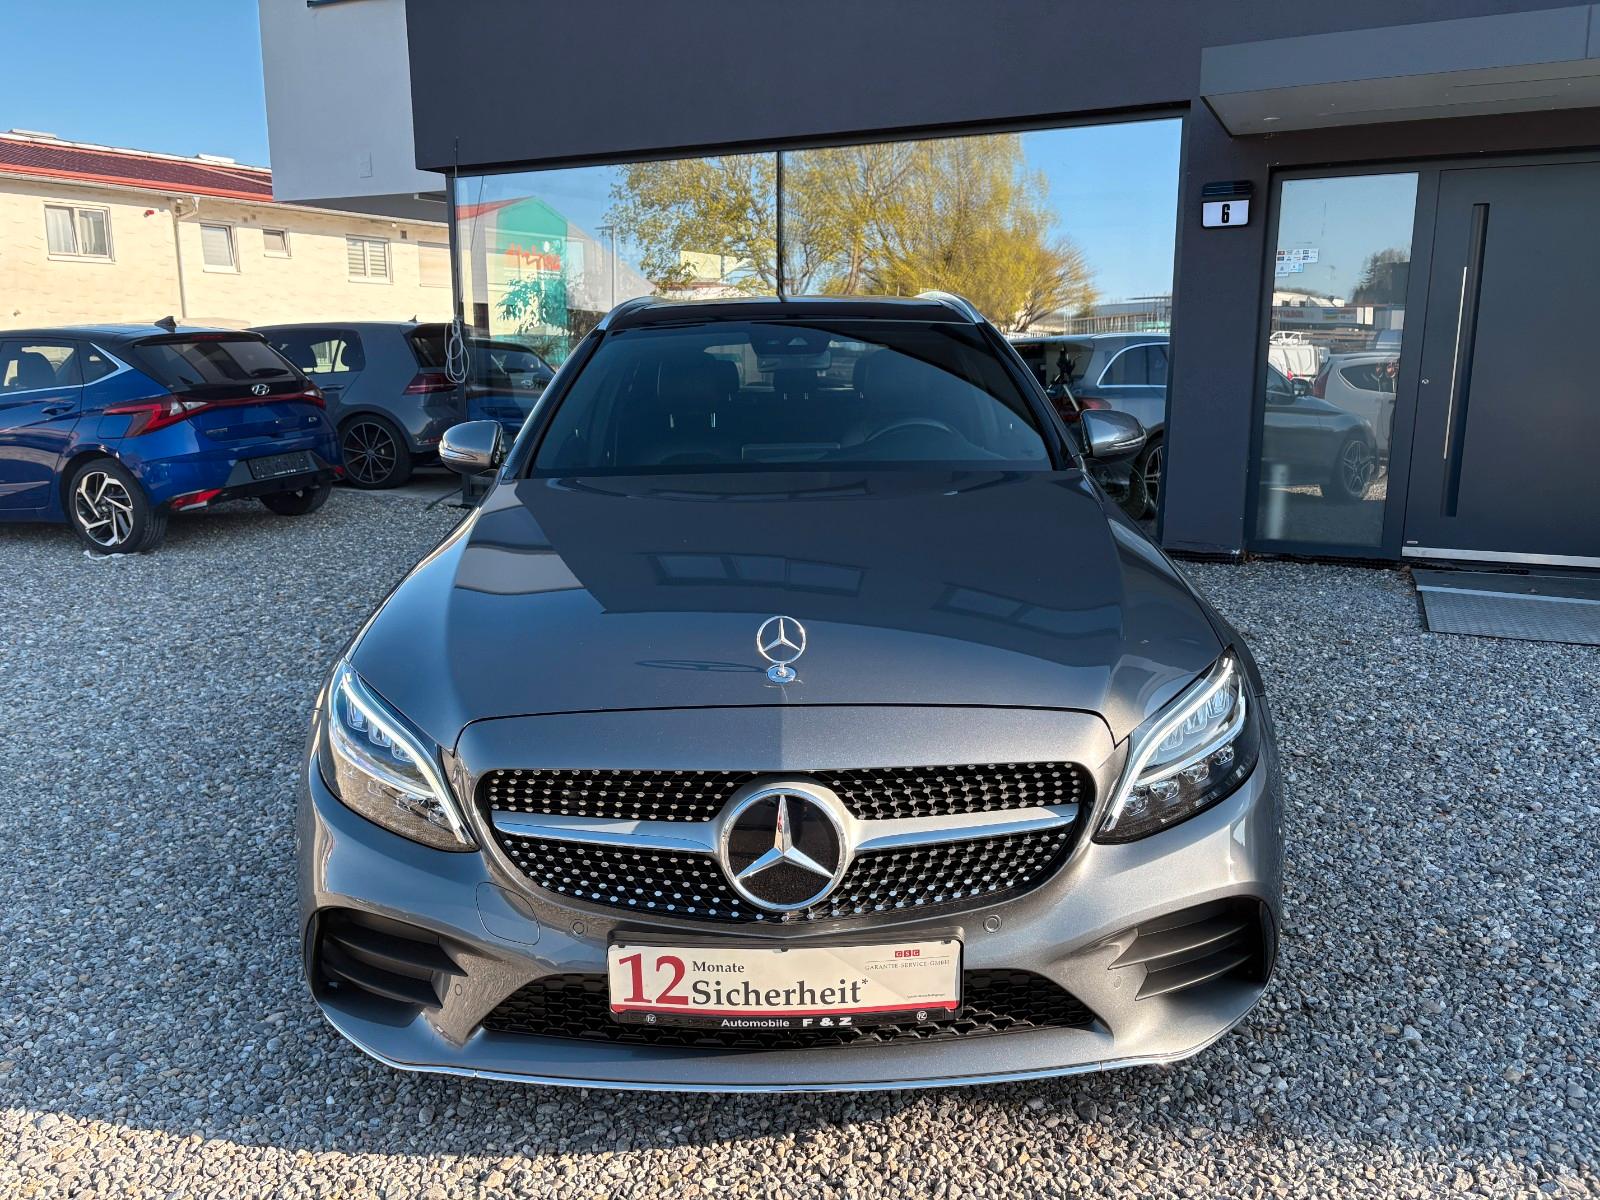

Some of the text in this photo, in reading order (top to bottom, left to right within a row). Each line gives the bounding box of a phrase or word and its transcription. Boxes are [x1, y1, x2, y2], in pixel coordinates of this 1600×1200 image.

[1221, 203, 1231, 224] 6
[895, 949, 920, 958] GSG
[692, 961, 745, 973] Monate
[618, 953, 689, 1006] 12
[720, 1016, 852, 1028] Automobile F & Z
